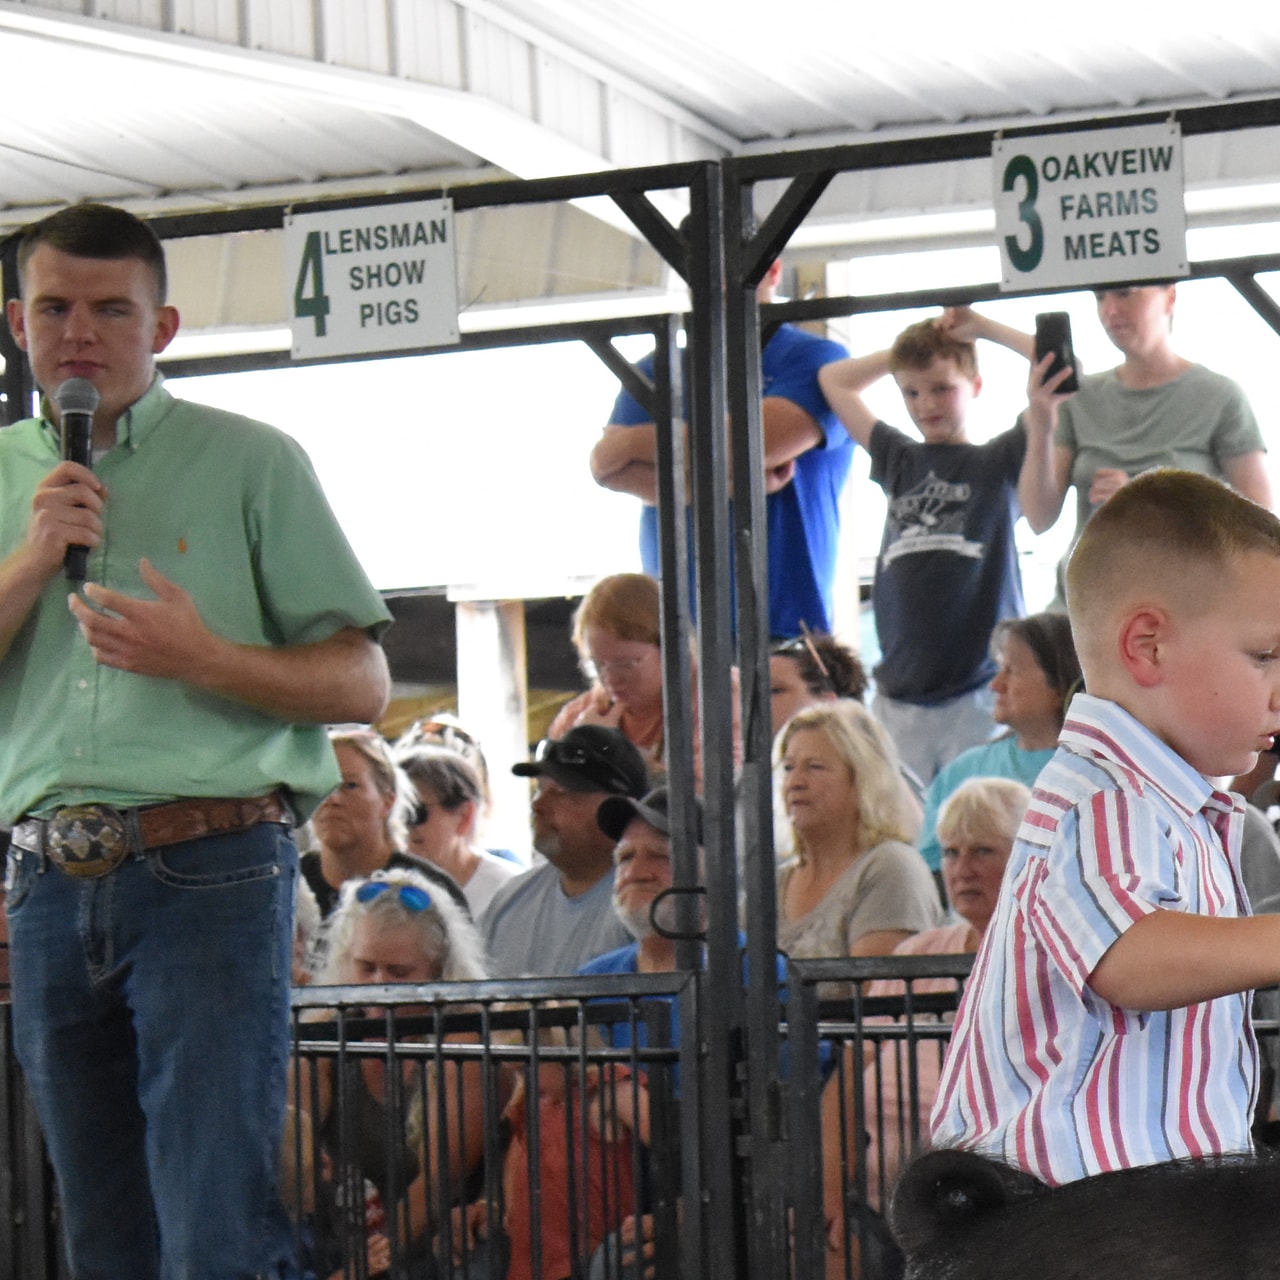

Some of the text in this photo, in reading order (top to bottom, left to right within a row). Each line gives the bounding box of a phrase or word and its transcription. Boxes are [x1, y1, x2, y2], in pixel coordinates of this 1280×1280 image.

[1041, 146, 1174, 182] OAKVEIW
[1002, 154, 1044, 273] 3
[1060, 187, 1159, 221] FARMS
[324, 218, 447, 256] LENSMAN
[1063, 227, 1160, 261] MEATS
[294, 231, 330, 337] 4
[349, 259, 425, 291] SHOW
[360, 298, 419, 328] PIGS
